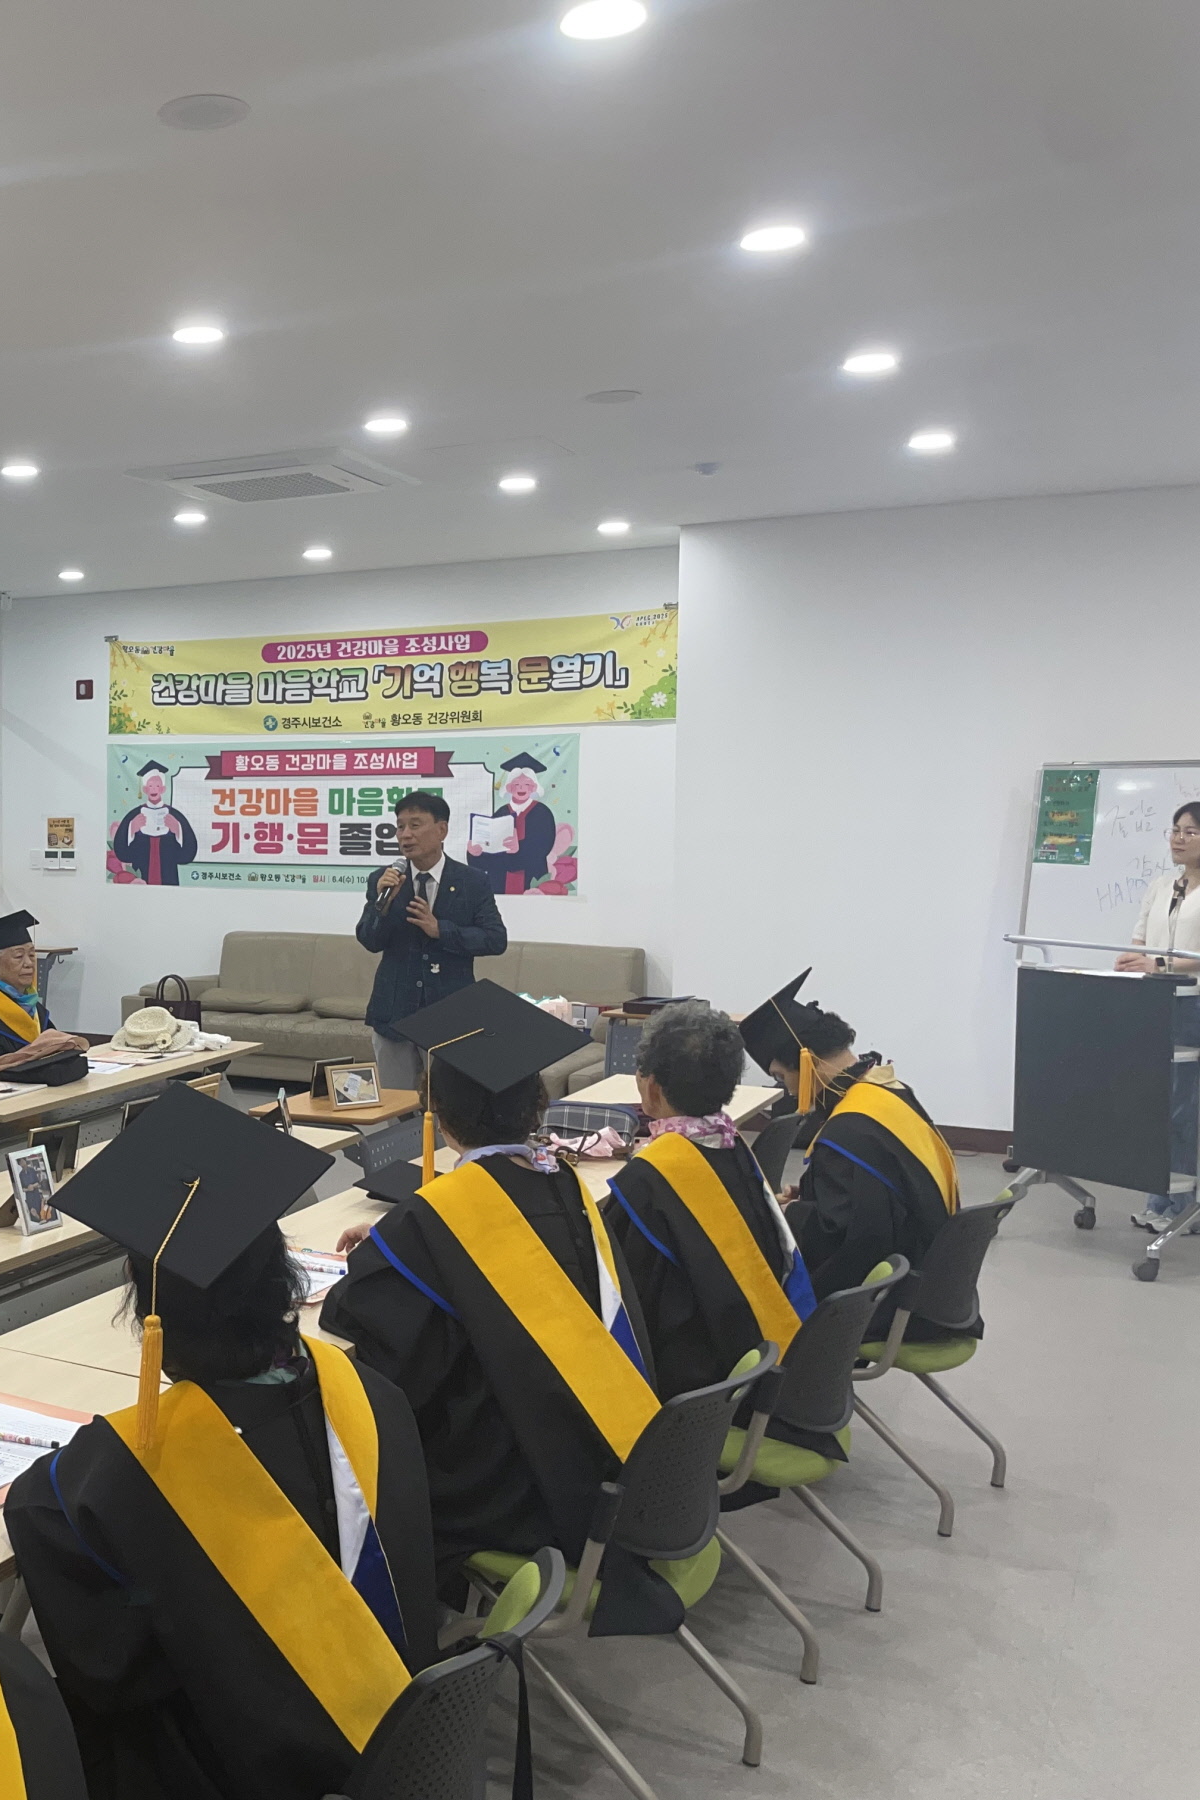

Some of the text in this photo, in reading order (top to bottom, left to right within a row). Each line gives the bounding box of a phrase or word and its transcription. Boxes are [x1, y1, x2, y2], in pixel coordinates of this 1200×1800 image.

[277, 634, 471, 660] 2025년 건강마을 조성사업
[152, 672, 253, 705] 건강마을
[257, 667, 369, 703] 마음학교
[449, 659, 512, 697] 행복
[281, 716, 342, 729] 경주시보건소
[390, 713, 423, 727] 황오동
[427, 710, 483, 725] 건강위원회
[235, 752, 418, 772] 황오동 건강마을 조성사업
[211, 787, 319, 817] 건강마을
[201, 872, 242, 881] 경주시보건소
[260, 872, 281, 882] 황오동
[312, 875, 326, 883] 일시
[332, 875, 355, 884] 6.4(수)
